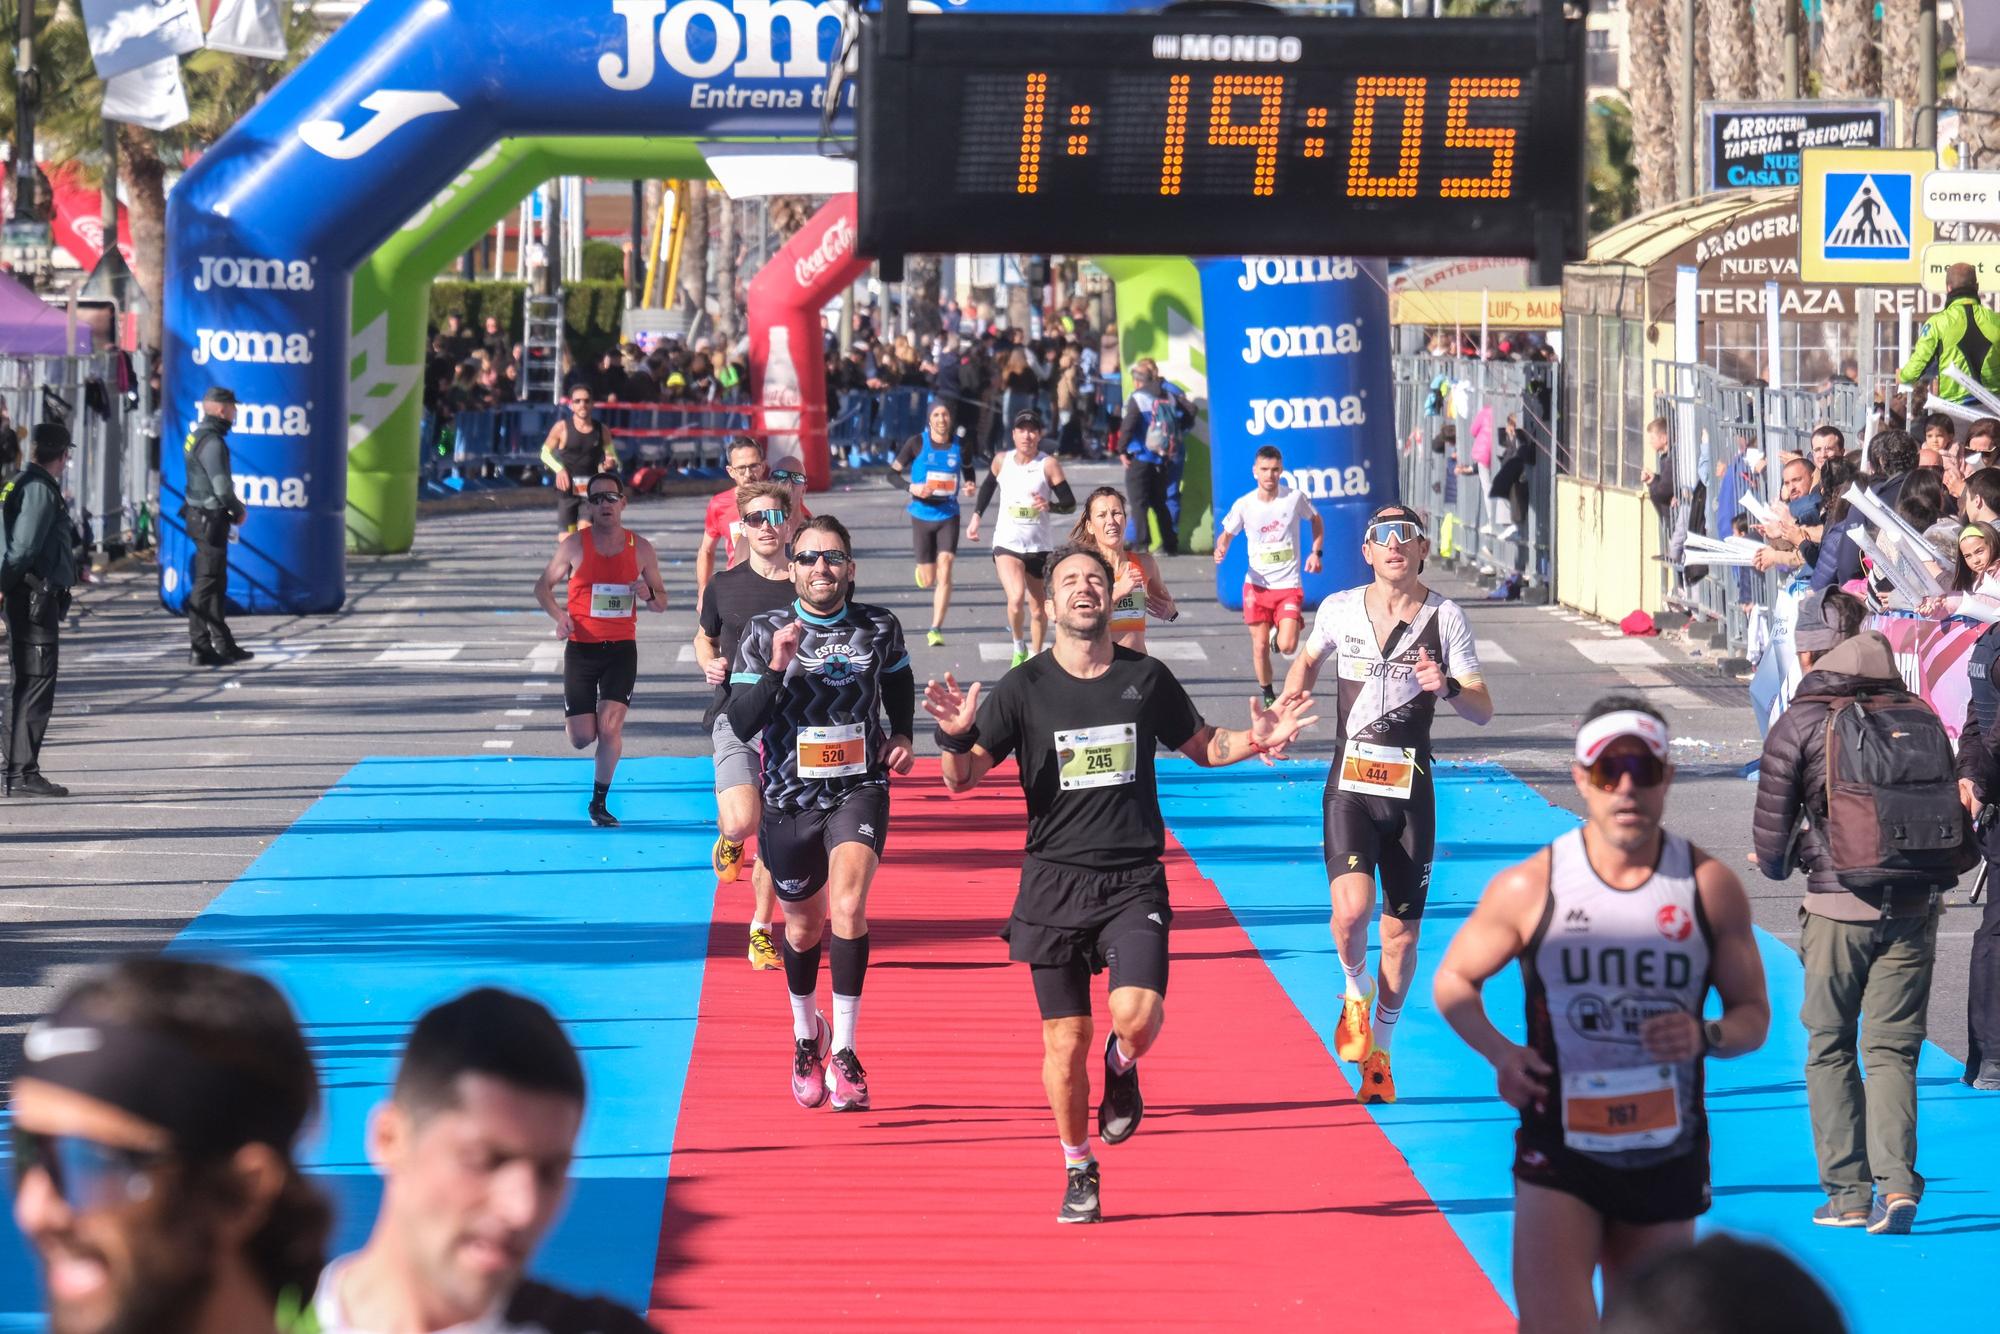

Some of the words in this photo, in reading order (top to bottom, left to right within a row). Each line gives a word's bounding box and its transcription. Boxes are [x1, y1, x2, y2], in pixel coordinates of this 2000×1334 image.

[598, 0, 859, 91] Jom
[1181, 34, 1302, 62] MONDO
[690, 83, 804, 109] Entrena
[1723, 117, 1807, 140] ARROCERIA
[1725, 136, 1783, 159] TAPERIA
[1797, 119, 1874, 148] FREIDURIA
[1930, 192, 1987, 203] comerç
[1696, 214, 1799, 263] ARROCERI
[1722, 258, 1798, 274] NUEVA
[192, 329, 312, 365] Joma
[1242, 323, 1362, 364] Joma
[1246, 395, 1366, 436] Joma
[815, 644, 857, 658] ESTESO
[822, 675, 856, 687] RUNNERS
[822, 750, 845, 762] 520
[1087, 754, 1113, 769] 245
[1366, 768, 1388, 781] 444
[1561, 947, 1691, 988] UNED
